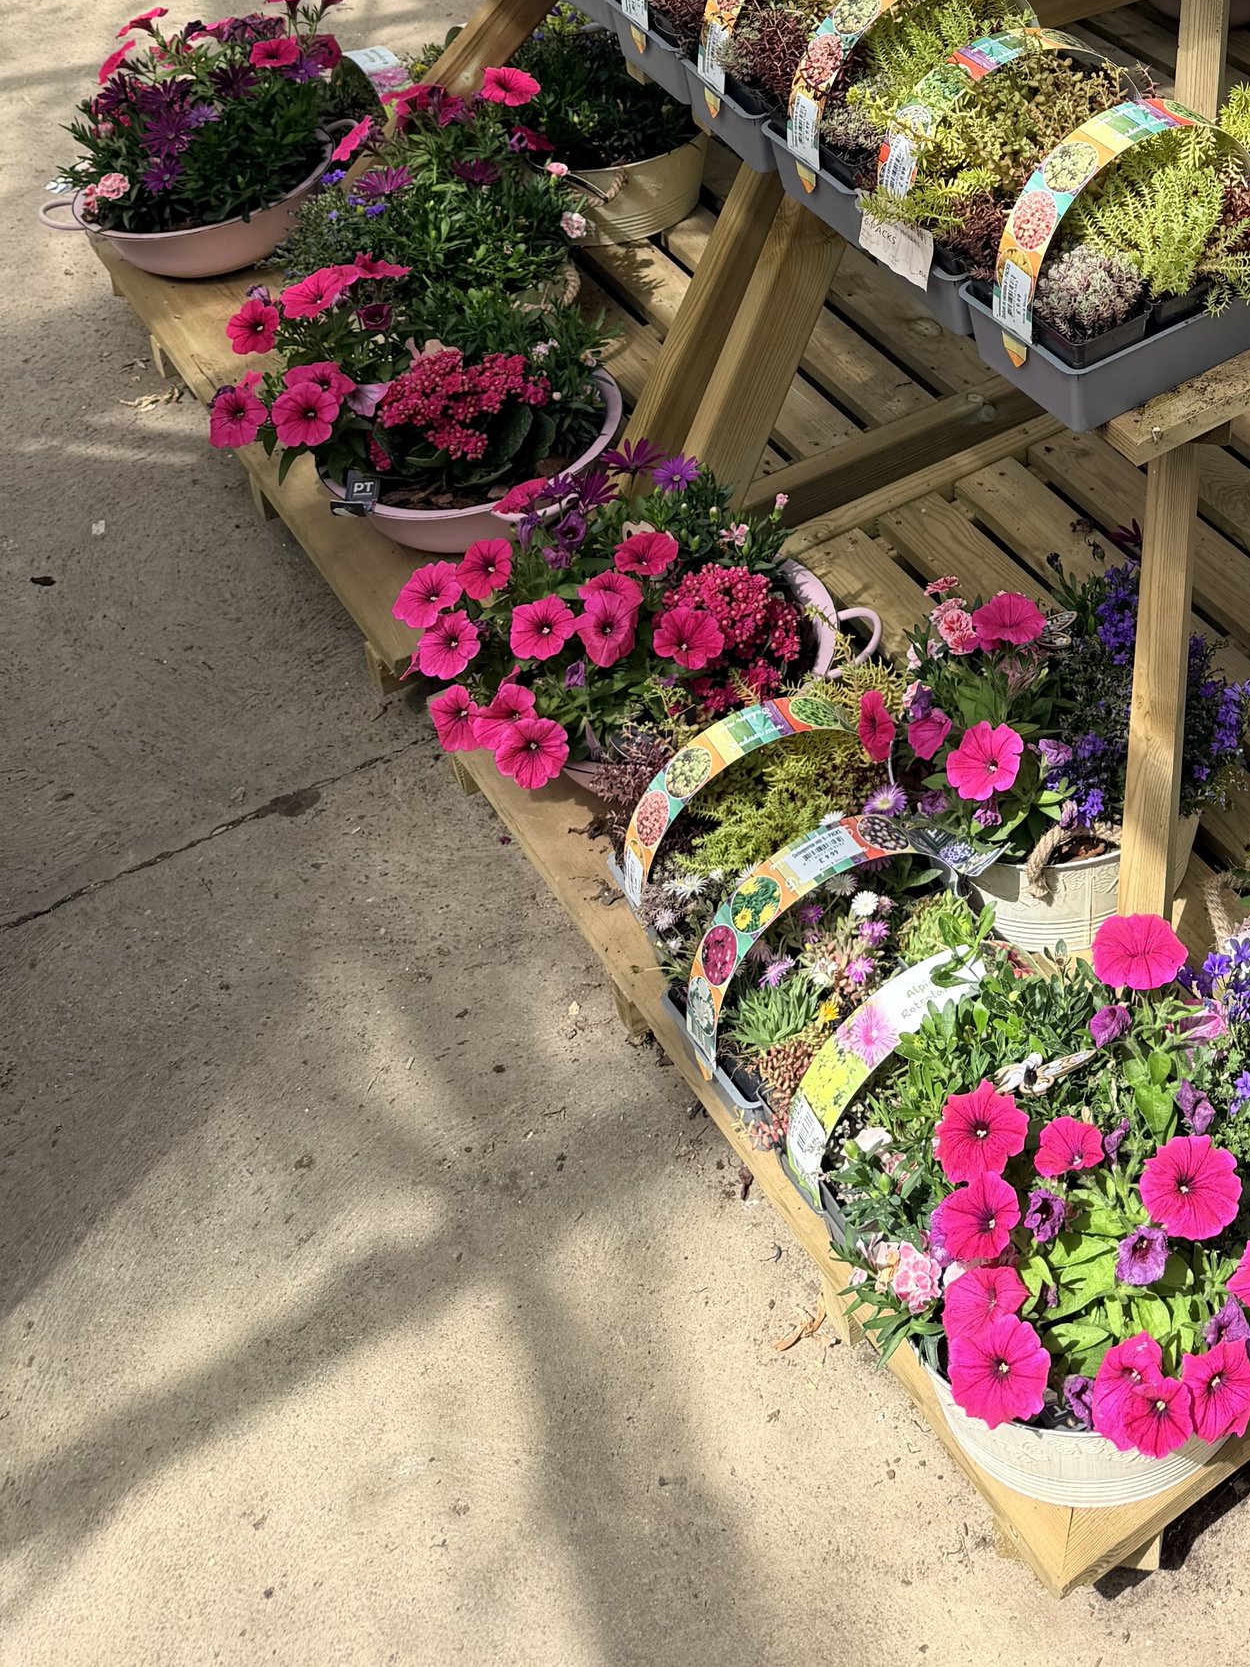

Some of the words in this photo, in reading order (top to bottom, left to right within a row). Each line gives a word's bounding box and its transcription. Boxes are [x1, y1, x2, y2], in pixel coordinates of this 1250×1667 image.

[353, 481, 374, 493] PT
[728, 729, 764, 751] Sedum
[821, 828, 841, 841] 6-PACKS
[824, 849, 839, 860] 9.99
[904, 976, 933, 1000] Alpi
